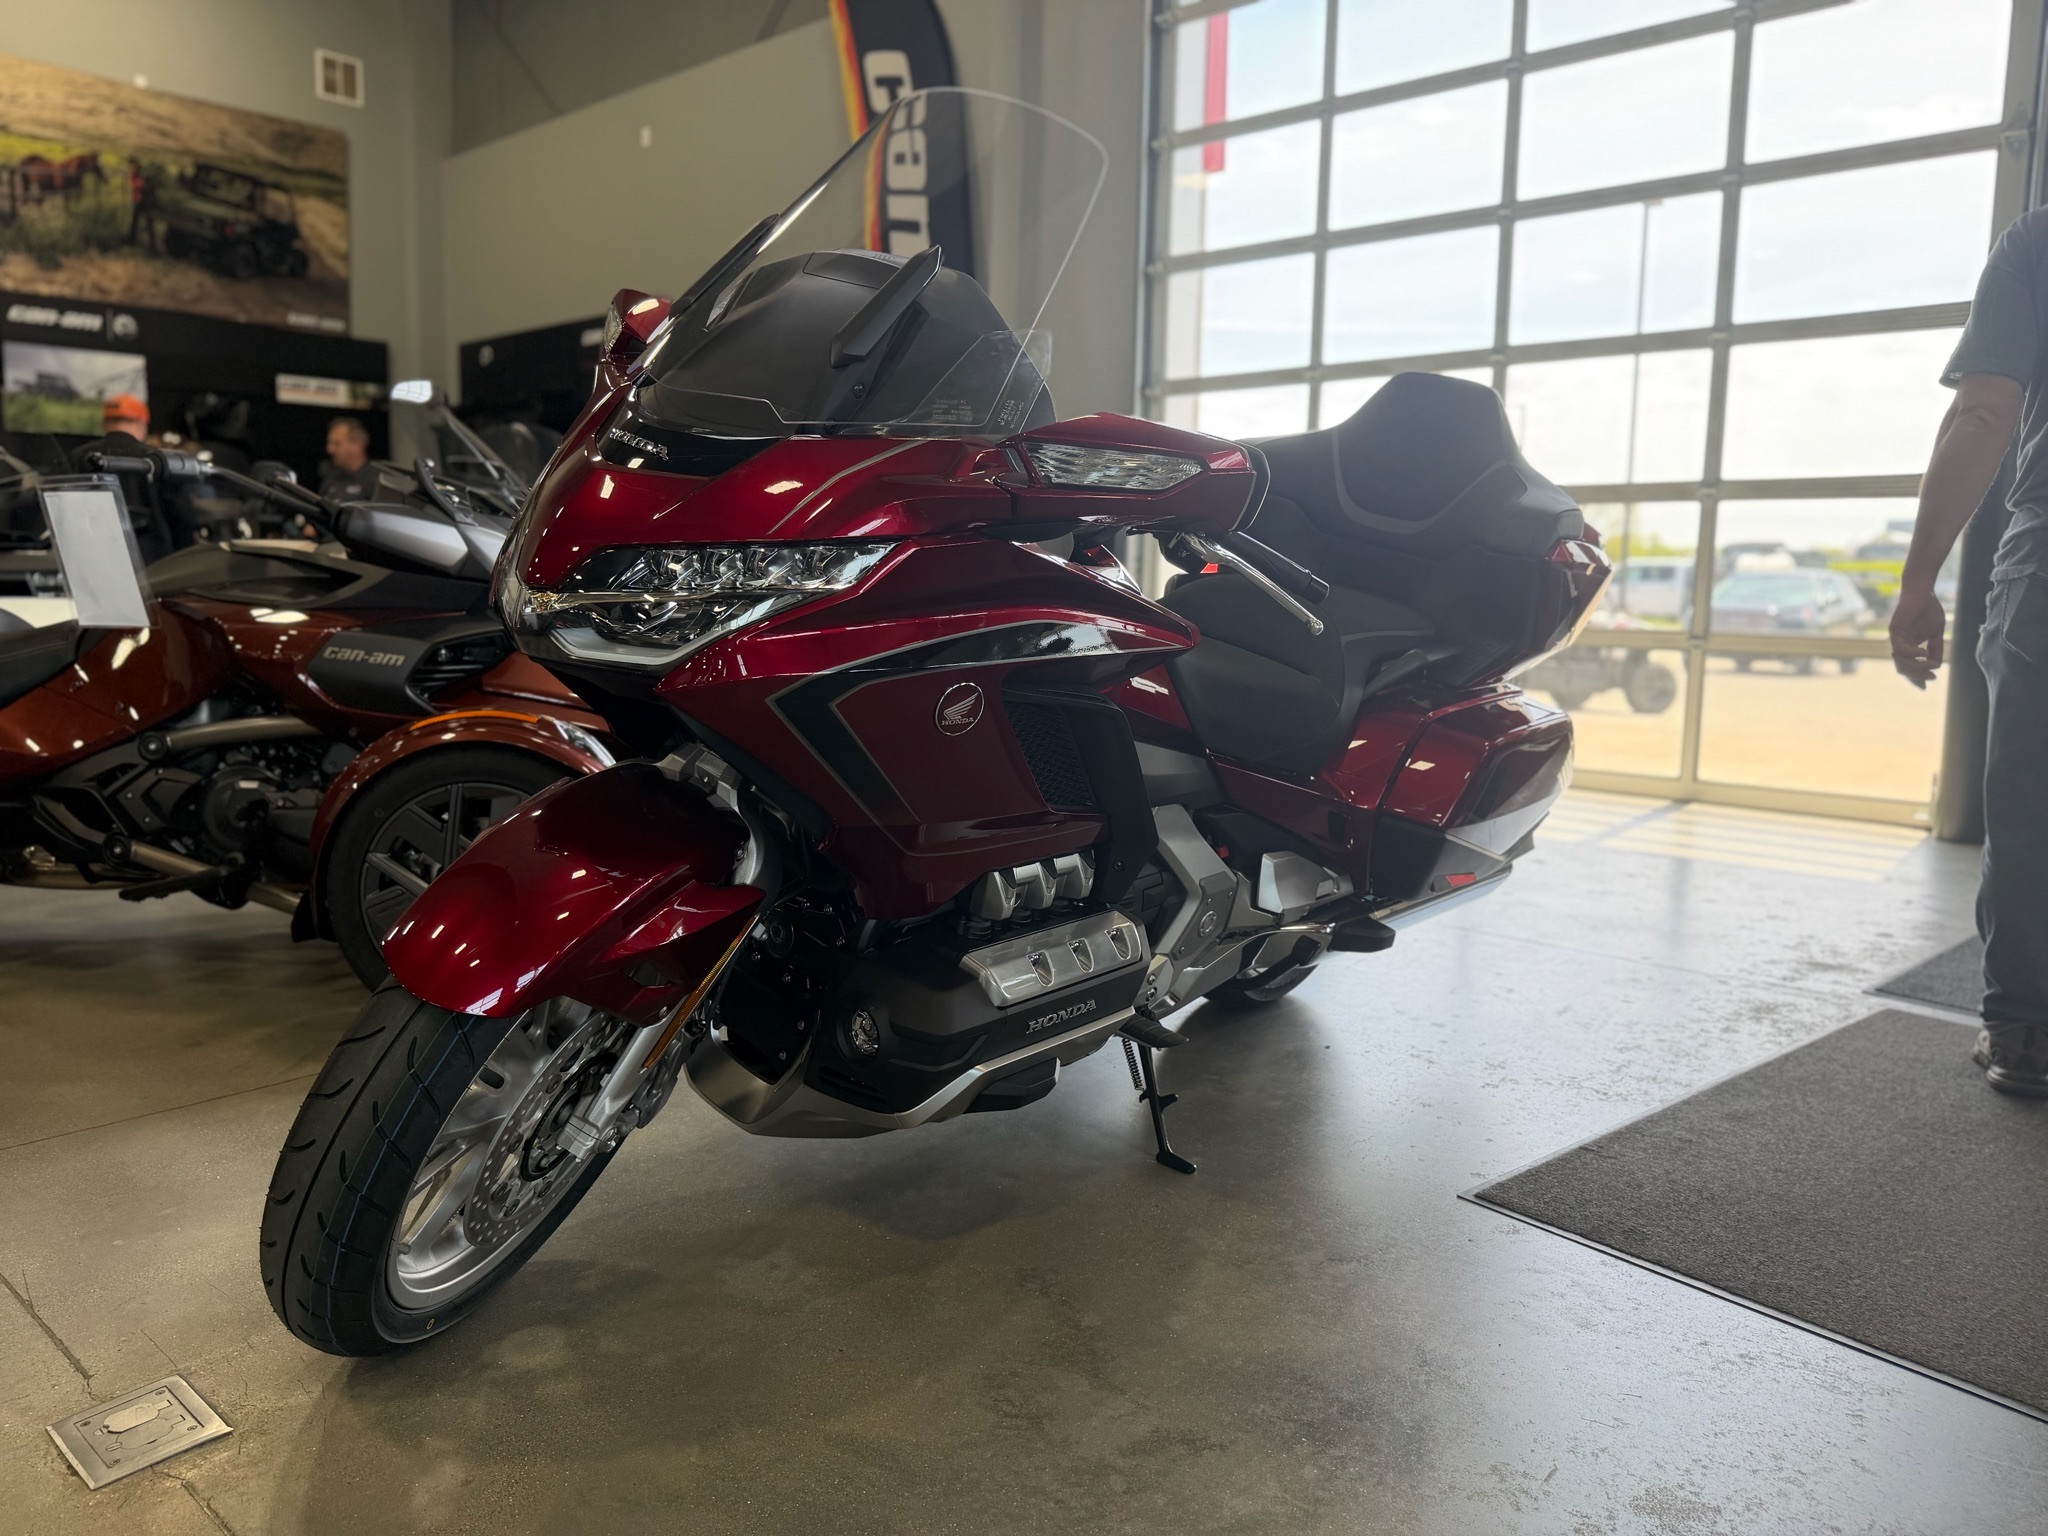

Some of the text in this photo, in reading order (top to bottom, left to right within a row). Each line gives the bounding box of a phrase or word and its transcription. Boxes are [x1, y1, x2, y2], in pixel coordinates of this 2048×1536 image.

[323, 646, 405, 667] can-am
[941, 717, 974, 726] HONDA
[1025, 999, 1097, 1034] HONDA
